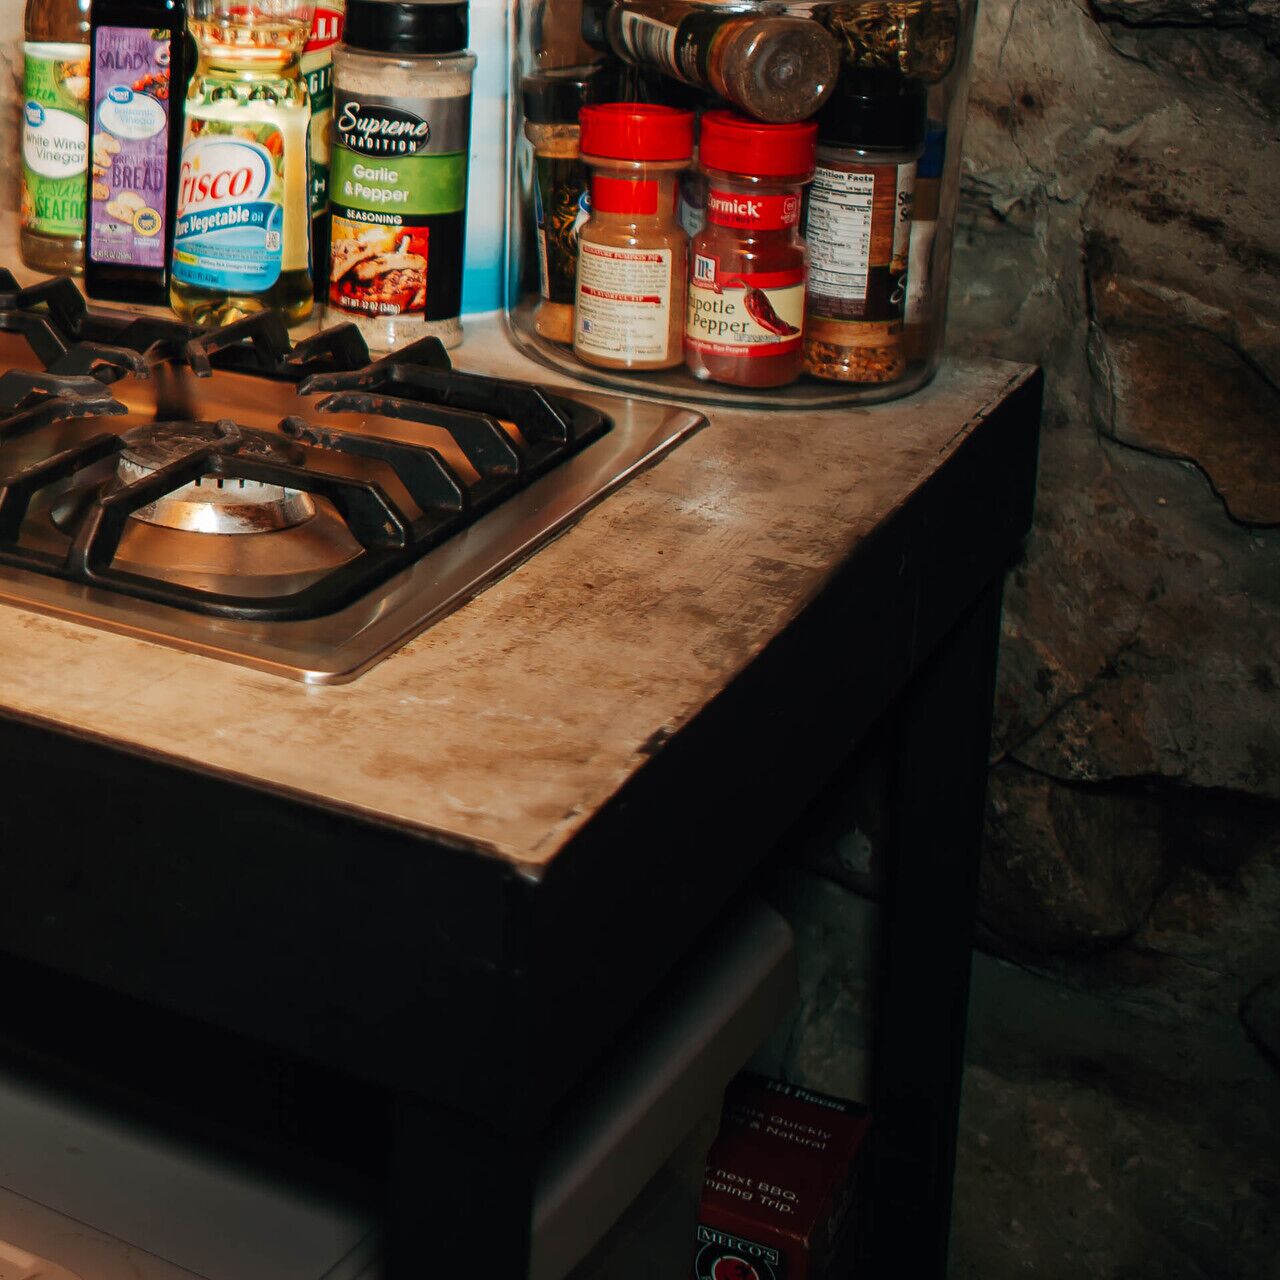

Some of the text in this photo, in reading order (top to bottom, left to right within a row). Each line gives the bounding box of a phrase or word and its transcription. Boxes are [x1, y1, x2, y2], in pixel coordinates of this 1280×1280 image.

[99, 49, 150, 69] SALADS
[338, 101, 429, 140] Supreme
[26, 133, 87, 150] White Wine
[345, 133, 416, 152] TRADITION
[36, 147, 85, 165] Vinegar
[112, 164, 164, 192] BREAD
[353, 163, 399, 184] Garlic
[355, 182, 409, 204] Pepper
[190, 205, 250, 233] Vegetable
[346, 209, 403, 225] SEASONING
[693, 313, 749, 335] Pepper
[766, 1125, 827, 1150] Natural
[771, 1114, 833, 1140] Quickly
[716, 1169, 752, 1187] next
[761, 1194, 795, 1215] Trip.
